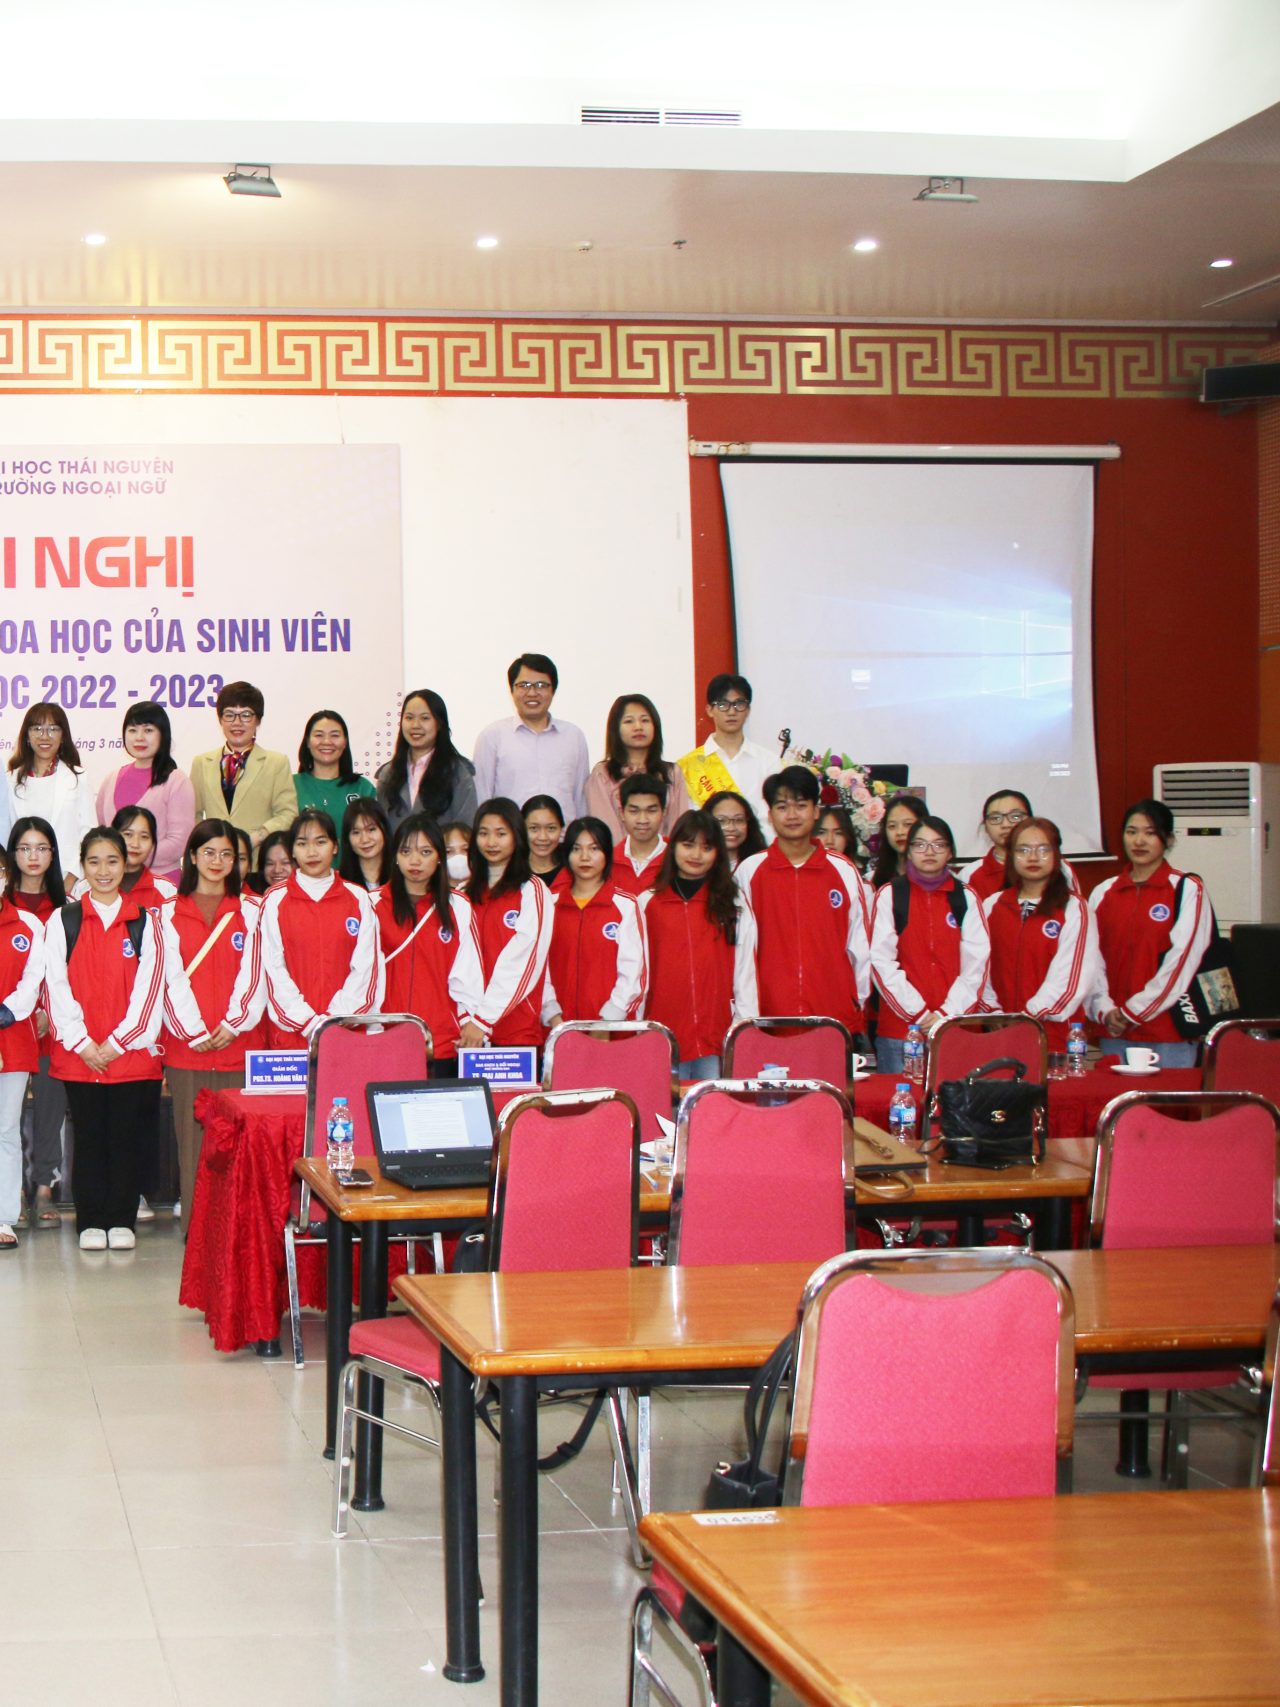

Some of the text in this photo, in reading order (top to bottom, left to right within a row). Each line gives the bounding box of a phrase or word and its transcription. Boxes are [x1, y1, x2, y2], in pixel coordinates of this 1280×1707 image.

[12, 461, 53, 479] HỌC
[58, 457, 98, 475] THÁI
[103, 457, 175, 475] NGUYÊN
[62, 481, 122, 499] NGOẠI
[127, 478, 168, 495] NGỮ
[34, 536, 194, 597] NGHỊ
[50, 618, 112, 661] HỌC
[123, 607, 186, 653] CỦA
[196, 618, 271, 653] SINH
[280, 611, 351, 653] VIÊN
[42, 675, 117, 709] 2022
[150, 674, 224, 709] 2023
[98, 740, 106, 749] 3
